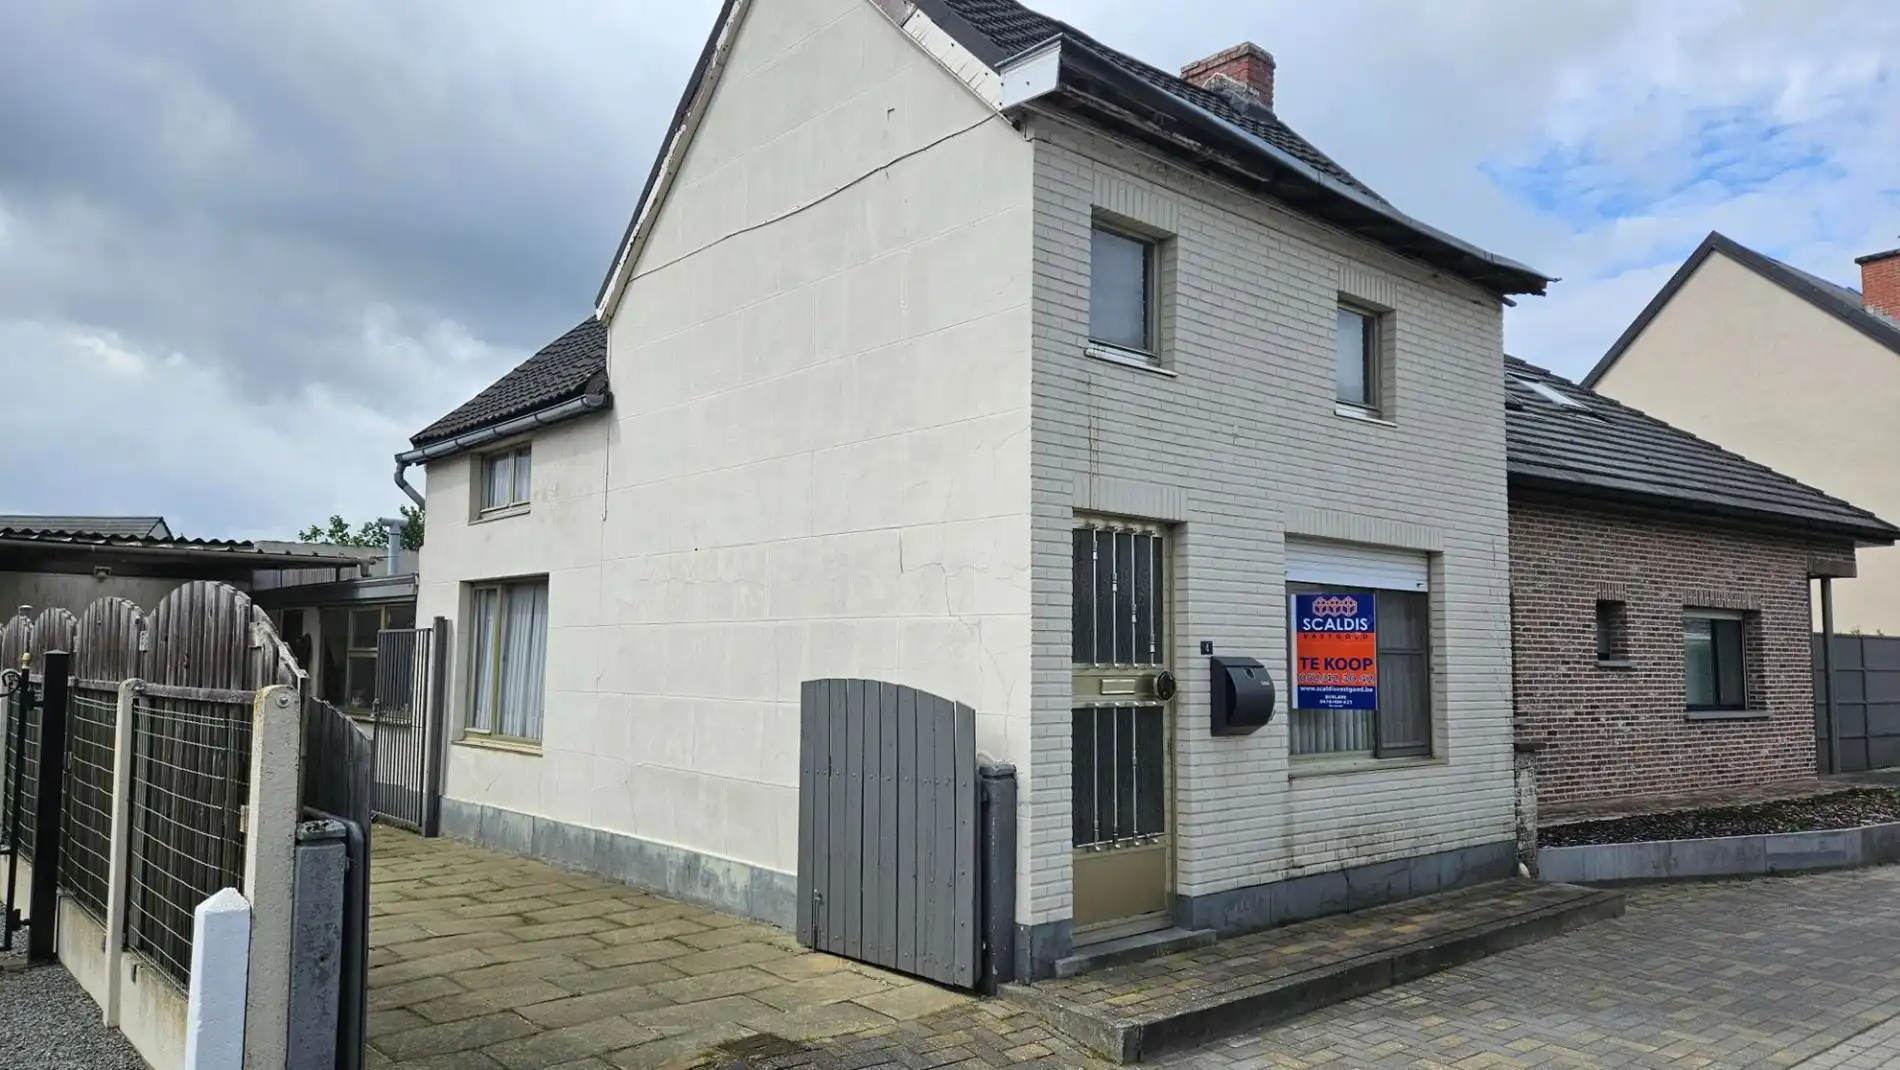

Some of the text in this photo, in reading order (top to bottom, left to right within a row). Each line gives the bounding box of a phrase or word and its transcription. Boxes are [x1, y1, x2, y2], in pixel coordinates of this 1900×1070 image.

[1303, 618, 1368, 631] SCALDIS
[1300, 657, 1373, 671] TE KOOP
